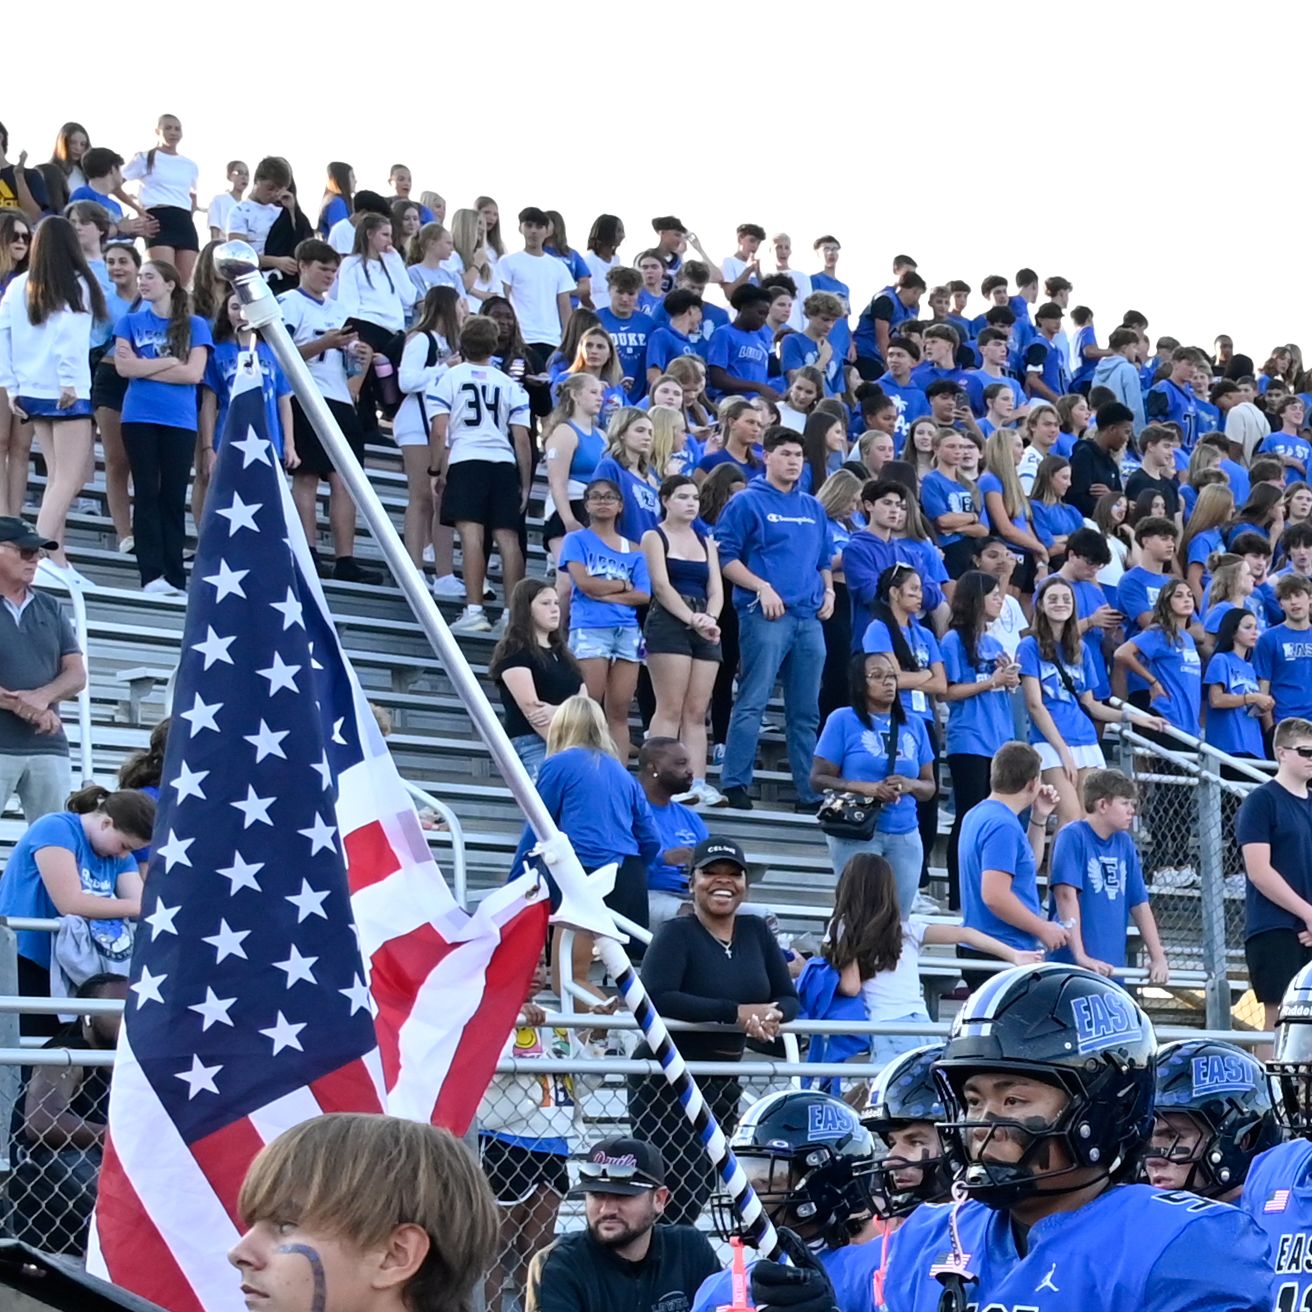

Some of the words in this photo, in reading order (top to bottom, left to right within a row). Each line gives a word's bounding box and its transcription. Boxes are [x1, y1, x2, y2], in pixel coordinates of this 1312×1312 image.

[611, 332, 647, 346] DUKE
[459, 382, 501, 428] 34
[807, 1104, 857, 1132] EAS
